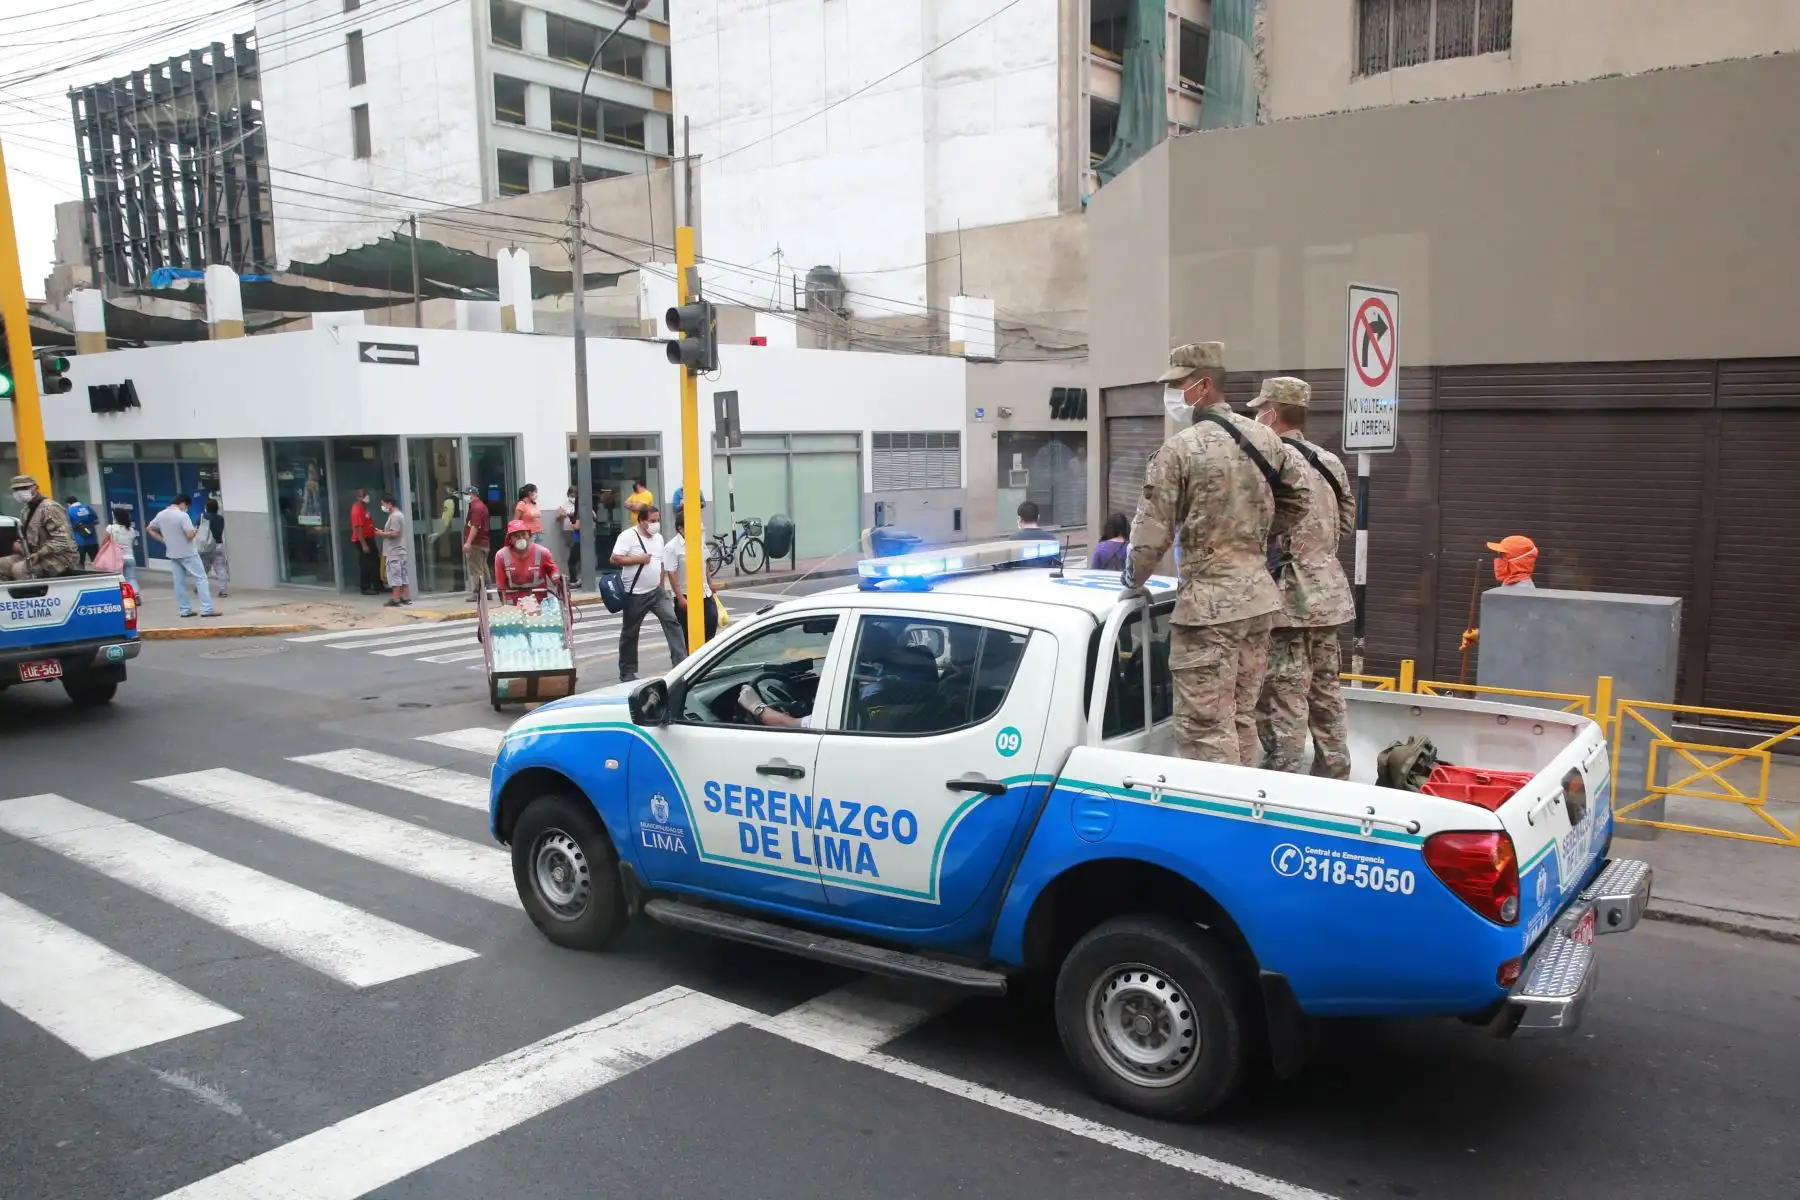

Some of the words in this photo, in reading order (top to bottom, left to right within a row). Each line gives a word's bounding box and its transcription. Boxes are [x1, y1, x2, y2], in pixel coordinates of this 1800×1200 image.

[1349, 398, 1358, 414] NO
[1350, 420, 1358, 436] LA
[1361, 420, 1391, 435] DERECHA
[0, 598, 61, 612] SERENAZGO
[11, 610, 25, 620] DE
[27, 608, 52, 619] LIMA
[997, 732, 1019, 751] 09
[703, 780, 918, 845] SERENAZGO
[641, 831, 688, 855] LIMA
[738, 821, 782, 860] DE
[791, 831, 880, 878] LIMA
[1304, 846, 1331, 858] Central
[1331, 850, 1341, 858] de
[1342, 851, 1385, 865] Emergencia
[1303, 856, 1416, 895] 318-5050
